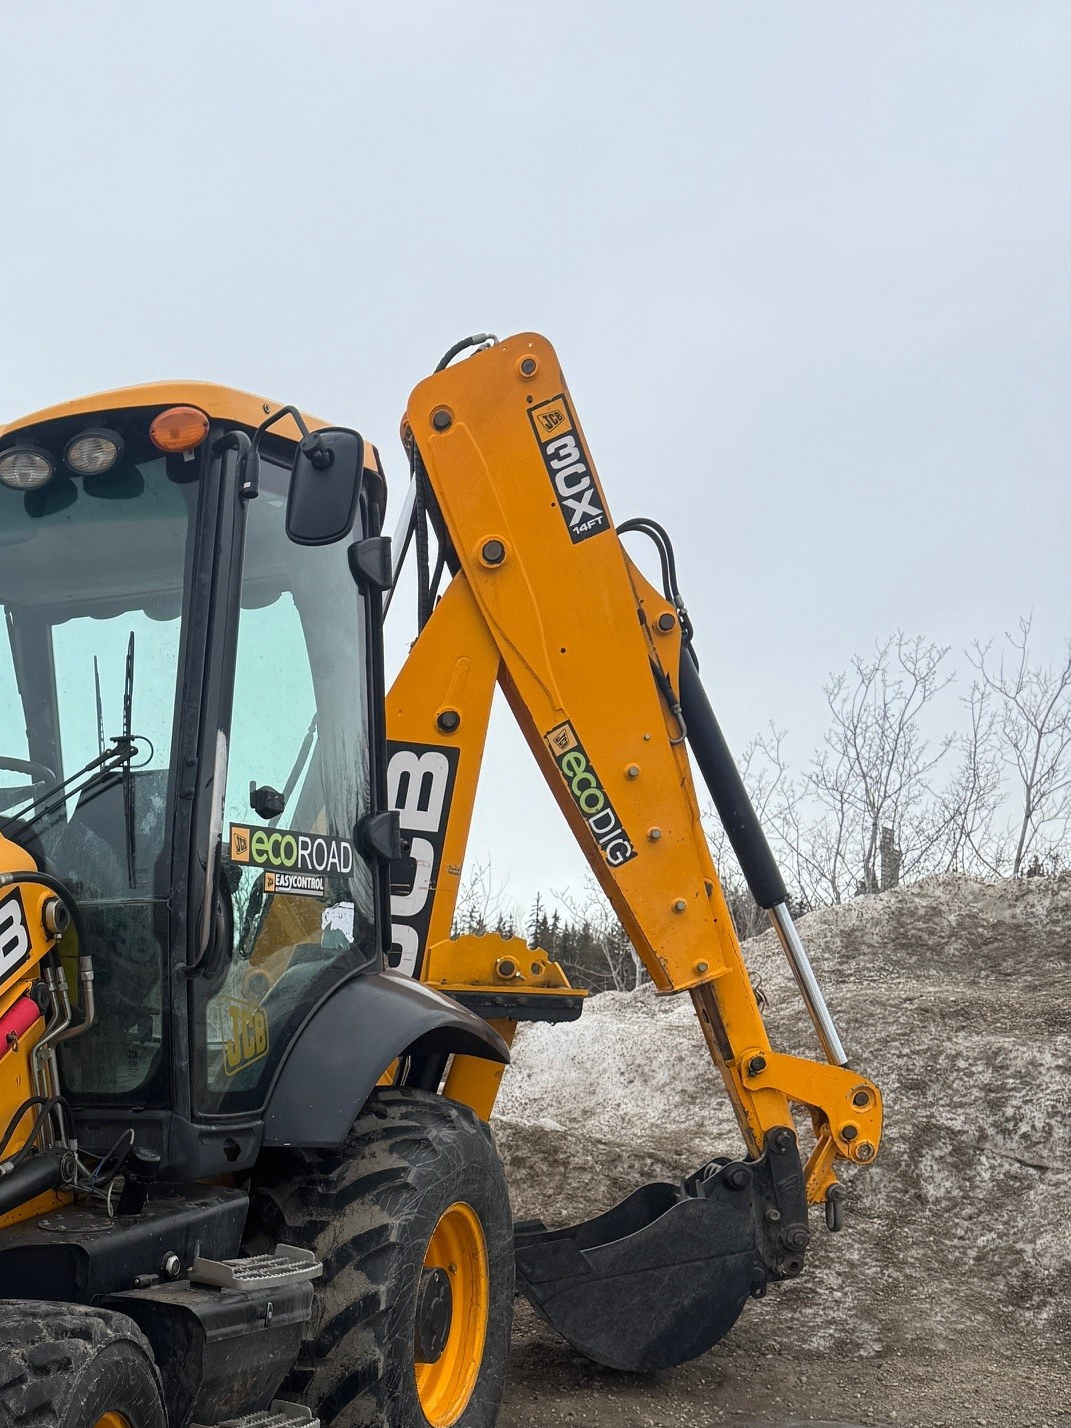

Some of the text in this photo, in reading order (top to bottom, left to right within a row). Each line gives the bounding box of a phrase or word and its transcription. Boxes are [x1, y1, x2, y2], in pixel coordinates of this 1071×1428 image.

[542, 411, 563, 430] JCB
[546, 435, 603, 527] 3CX
[573, 516, 603, 535] 14FT
[561, 751, 631, 865] ecoDIG
[251, 830, 353, 873] ecoROAD
[275, 873, 324, 891] EASYCONTROL
[227, 1006, 266, 1066] JCB
